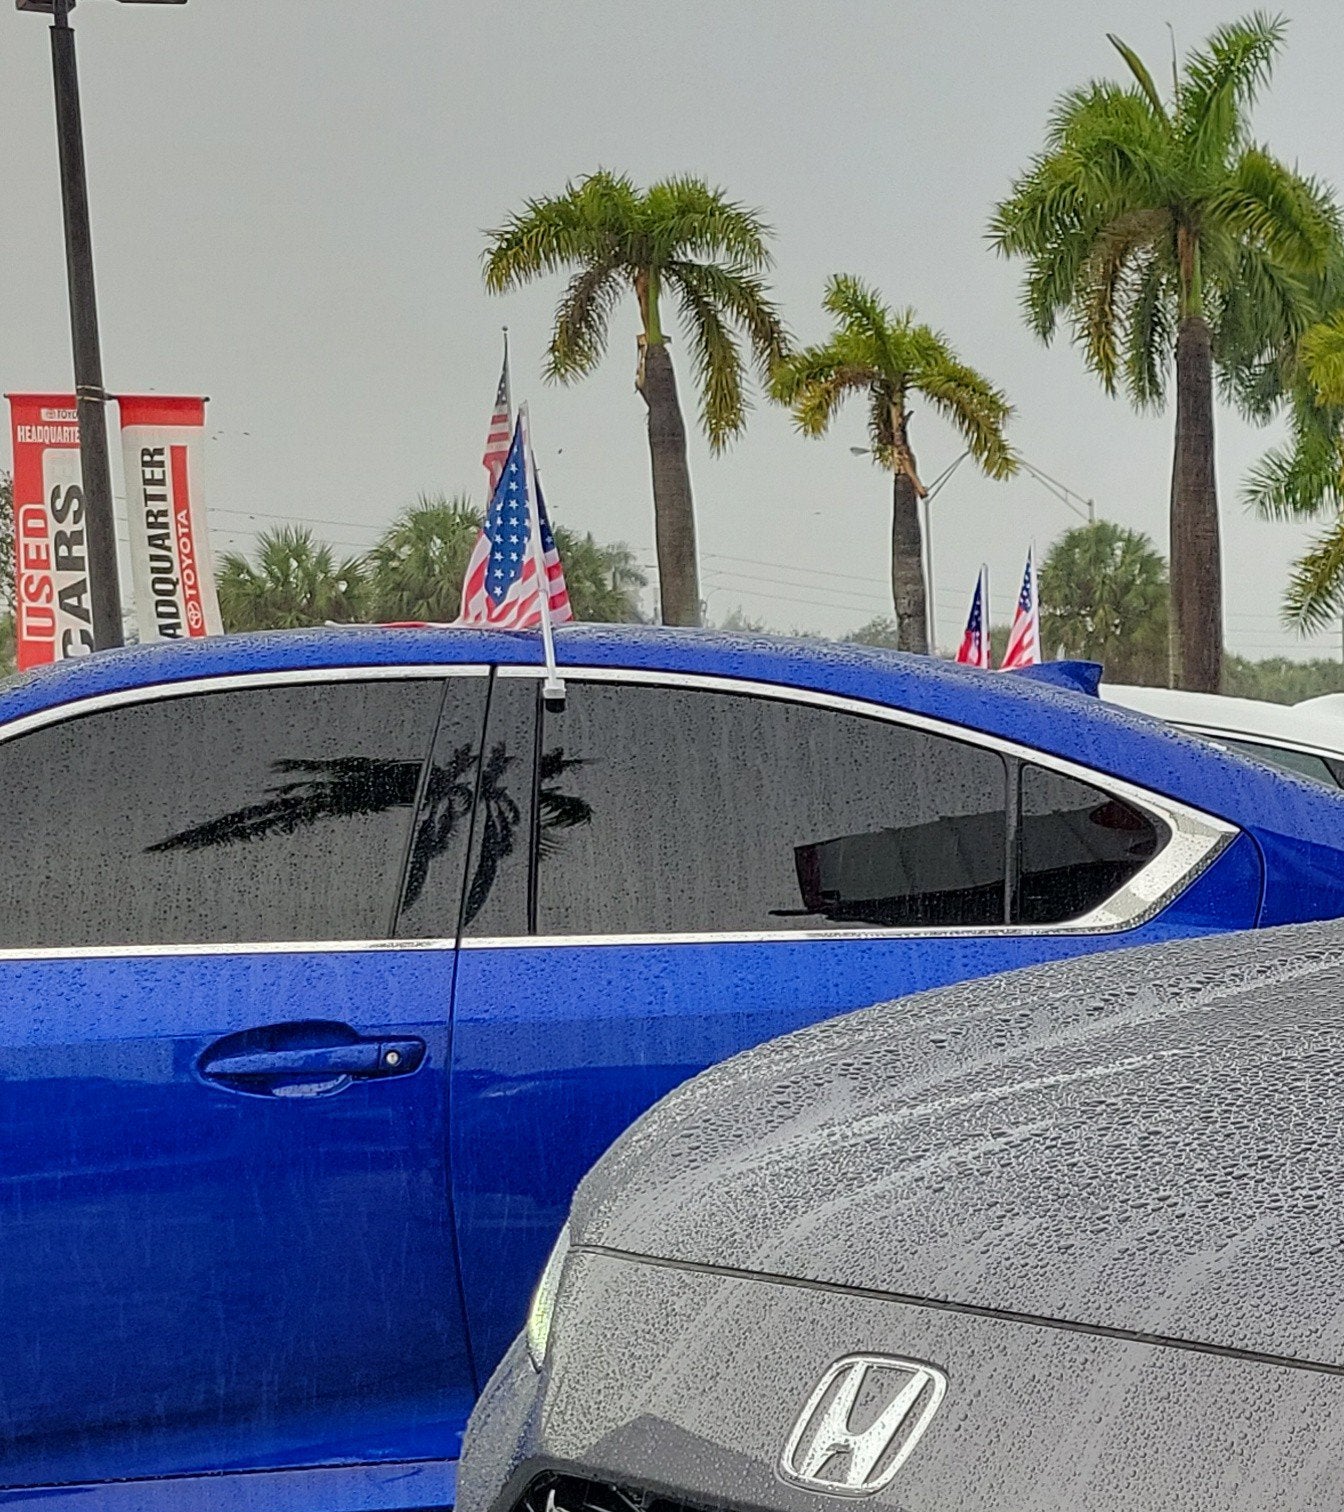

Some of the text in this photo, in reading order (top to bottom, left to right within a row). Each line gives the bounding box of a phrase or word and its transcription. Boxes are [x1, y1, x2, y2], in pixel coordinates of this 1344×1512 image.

[17, 425, 80, 444] HEADQUARTE
[21, 506, 56, 639] USED
[50, 484, 94, 658] CARS
[141, 447, 184, 639] ADQUARTER
[177, 508, 197, 598] TOYOTA
